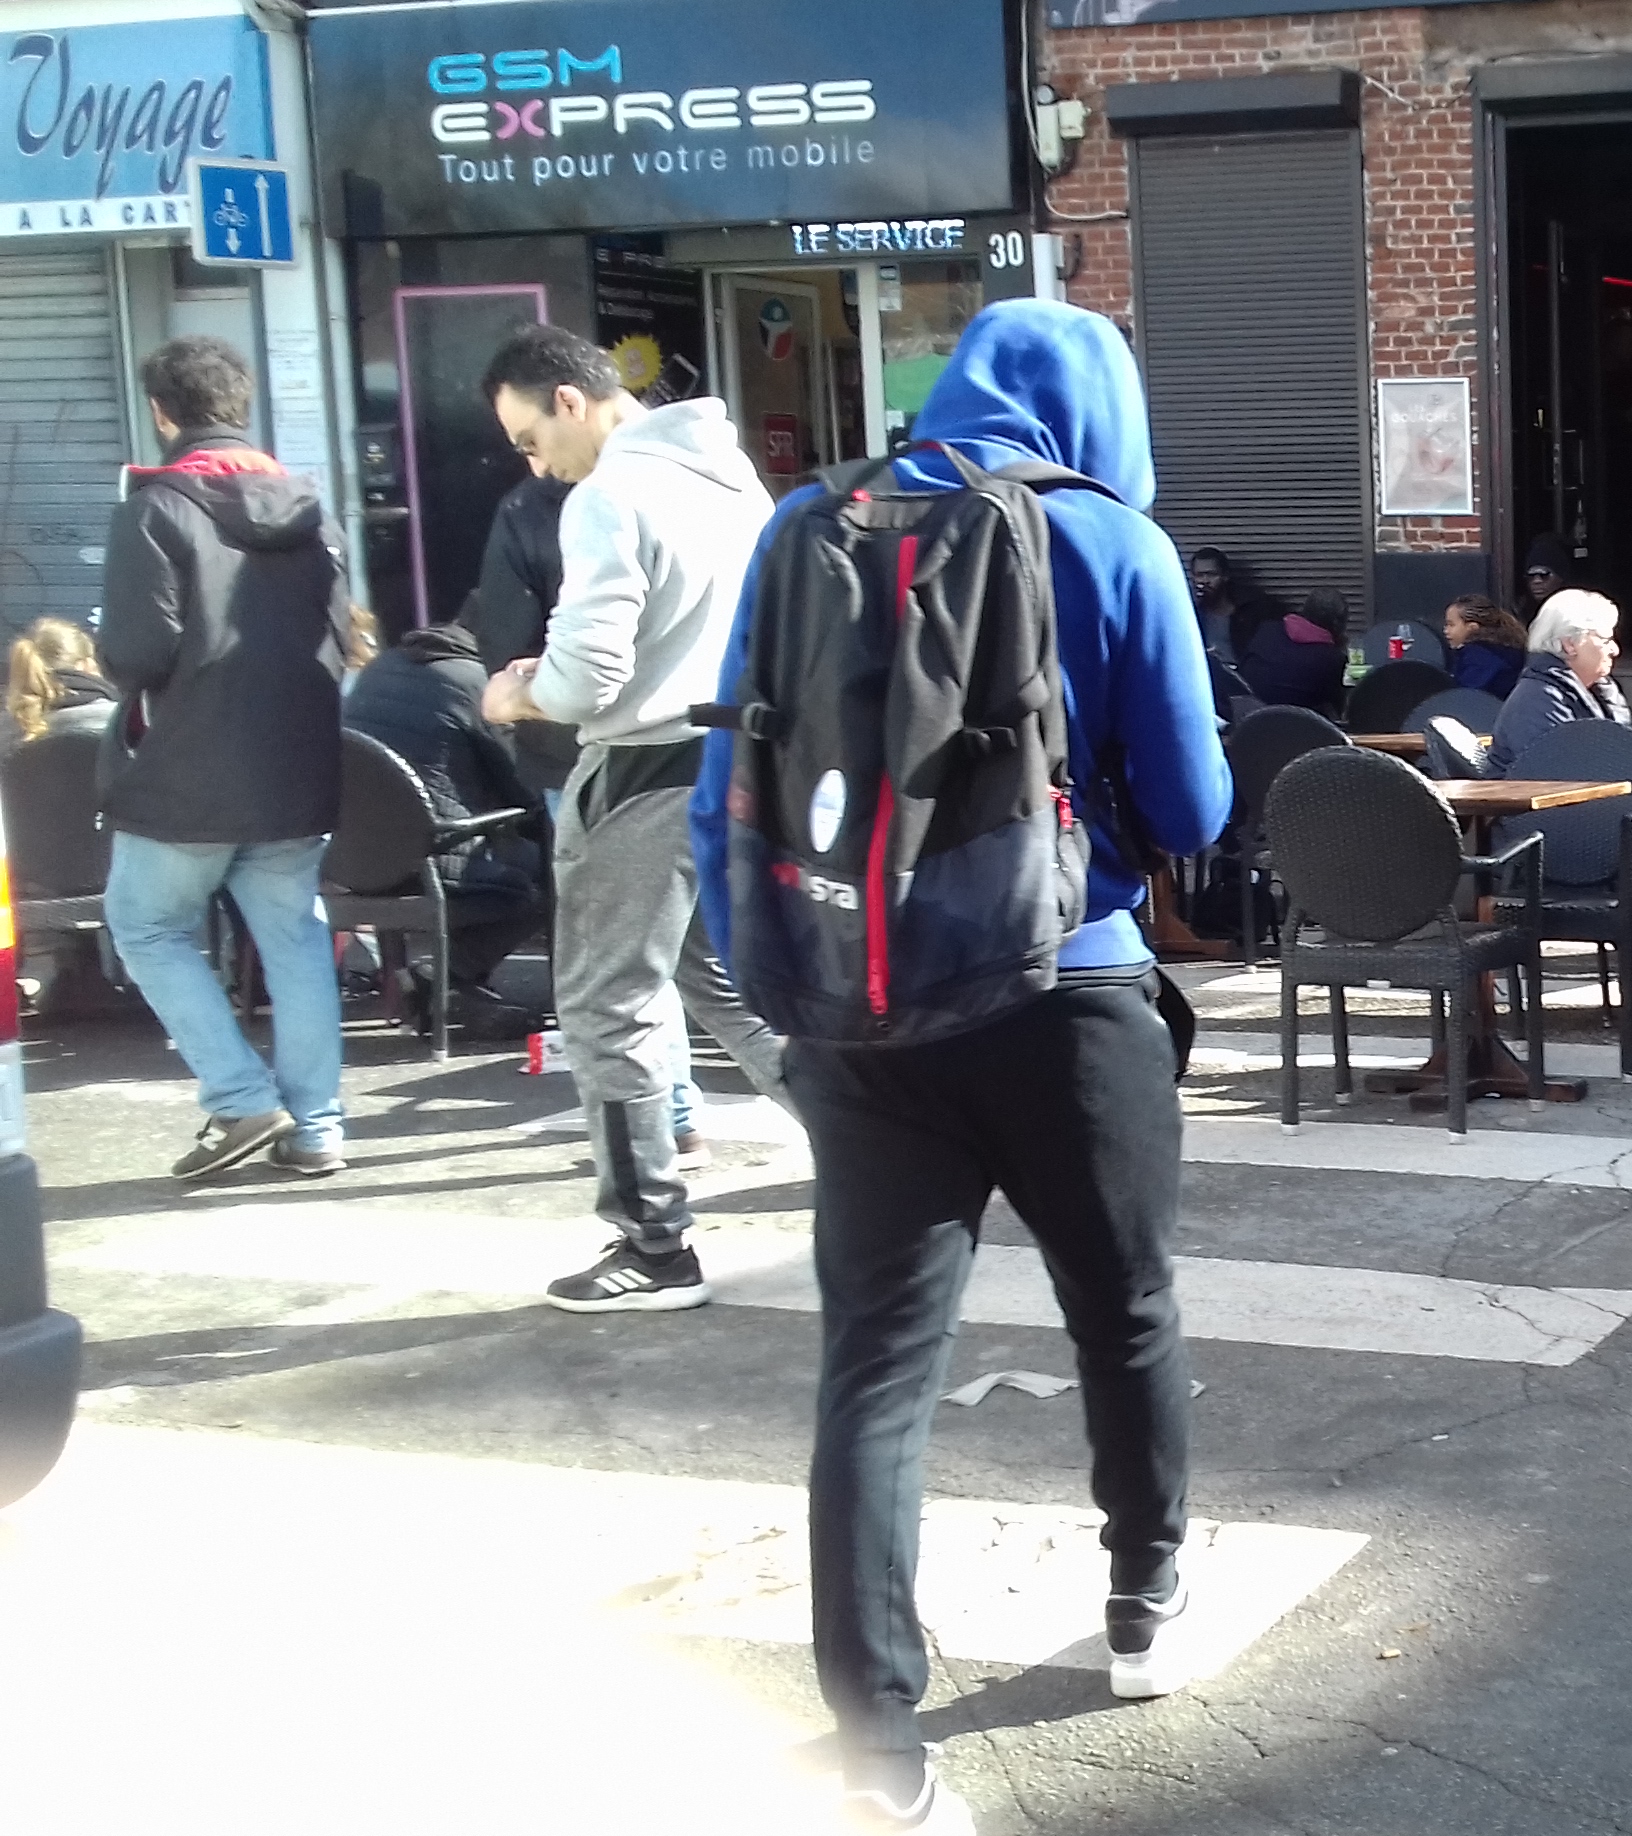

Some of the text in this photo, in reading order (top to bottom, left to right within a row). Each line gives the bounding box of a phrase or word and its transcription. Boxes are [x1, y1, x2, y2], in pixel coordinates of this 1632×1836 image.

[427, 45, 623, 95] GSM
[7, 33, 233, 199] Voyage
[430, 79, 877, 143] EXPRESS
[437, 136, 876, 187] Tout pour votre mobile
[19, 198, 190, 230] A LA CAR
[794, 218, 965, 256] LE SERVICE
[988, 231, 1024, 268] 30
